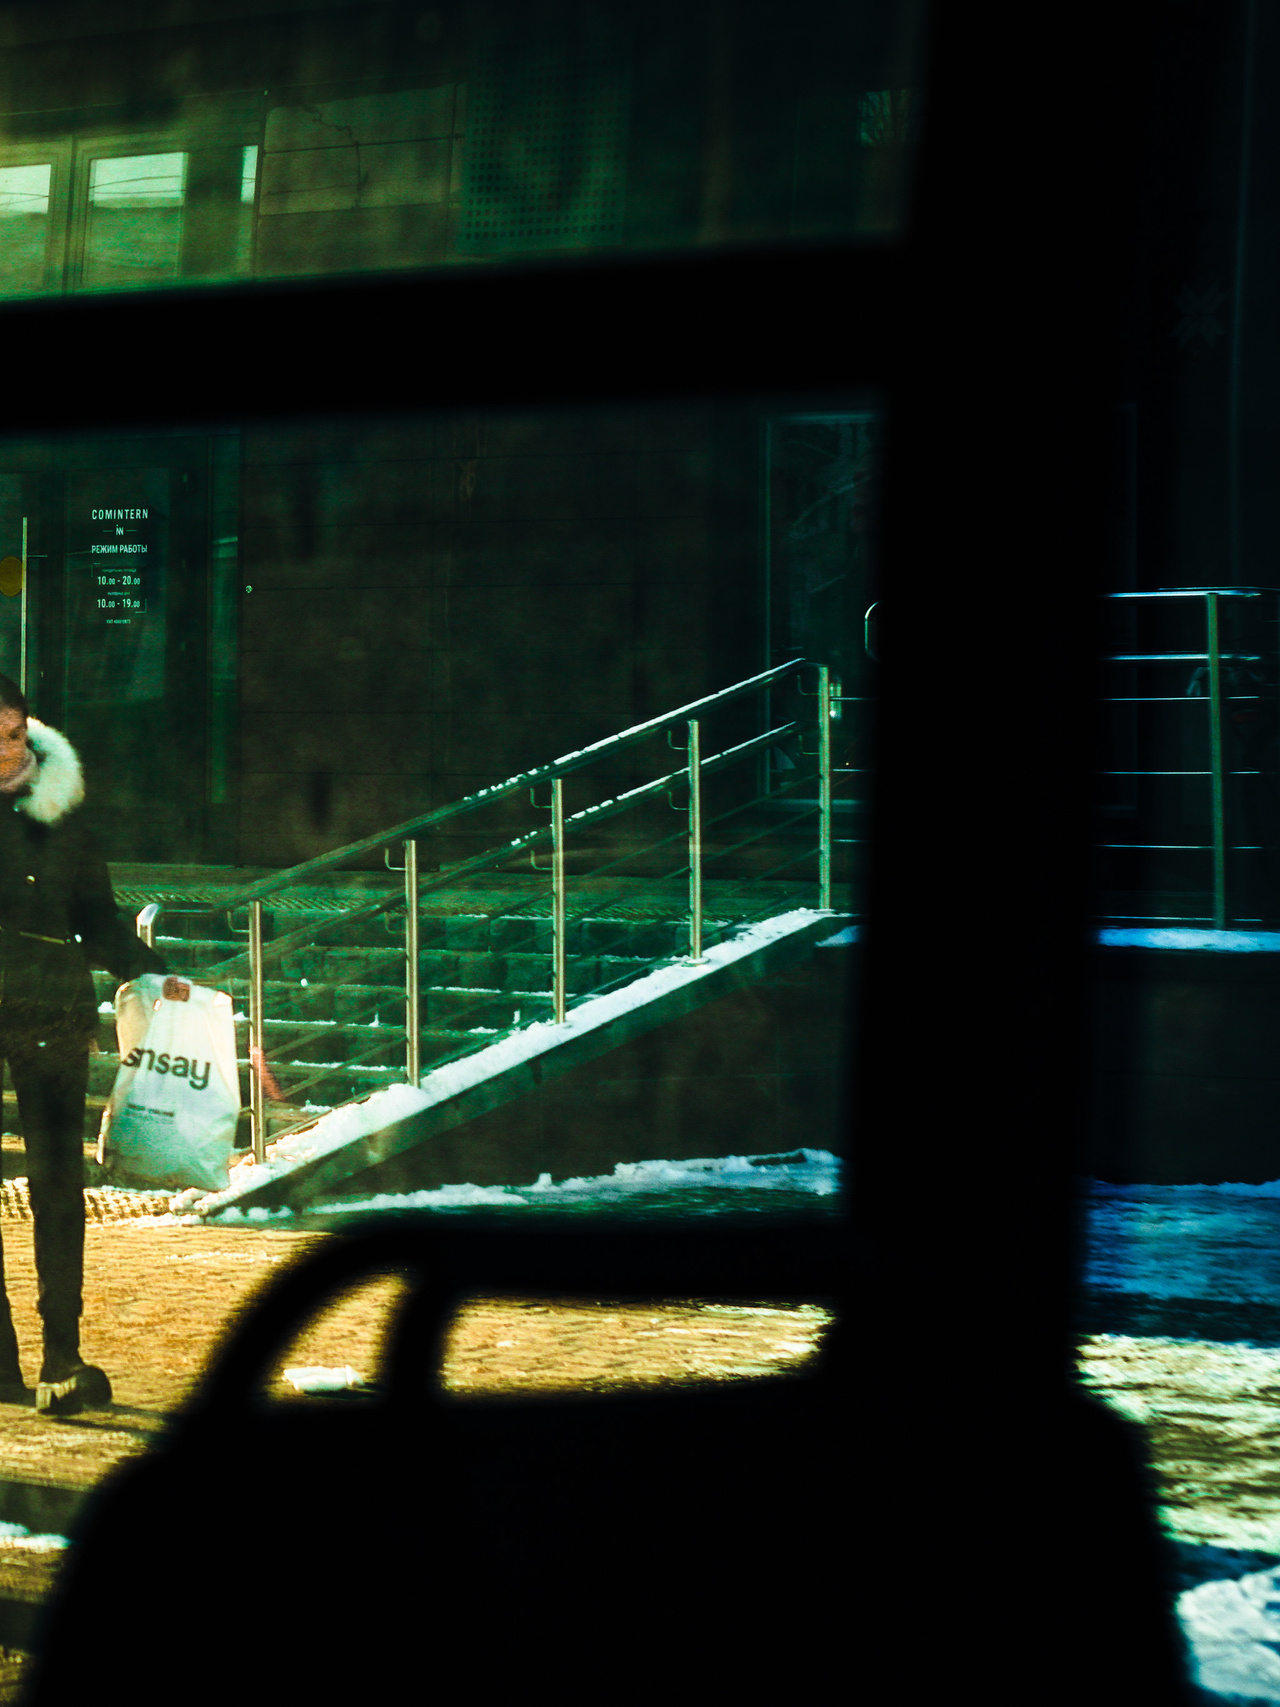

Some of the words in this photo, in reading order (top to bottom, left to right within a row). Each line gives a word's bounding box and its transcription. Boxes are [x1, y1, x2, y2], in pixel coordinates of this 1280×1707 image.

[91, 508, 149, 520] COMINTERN
[91, 544, 118, 554] РЕЖИМ
[119, 544, 148, 554] РАБОТЫ
[97, 575, 116, 585] 10.00
[122, 575, 141, 585] 20.00
[97, 598, 116, 608] 10.00
[122, 598, 141, 608] 19.00
